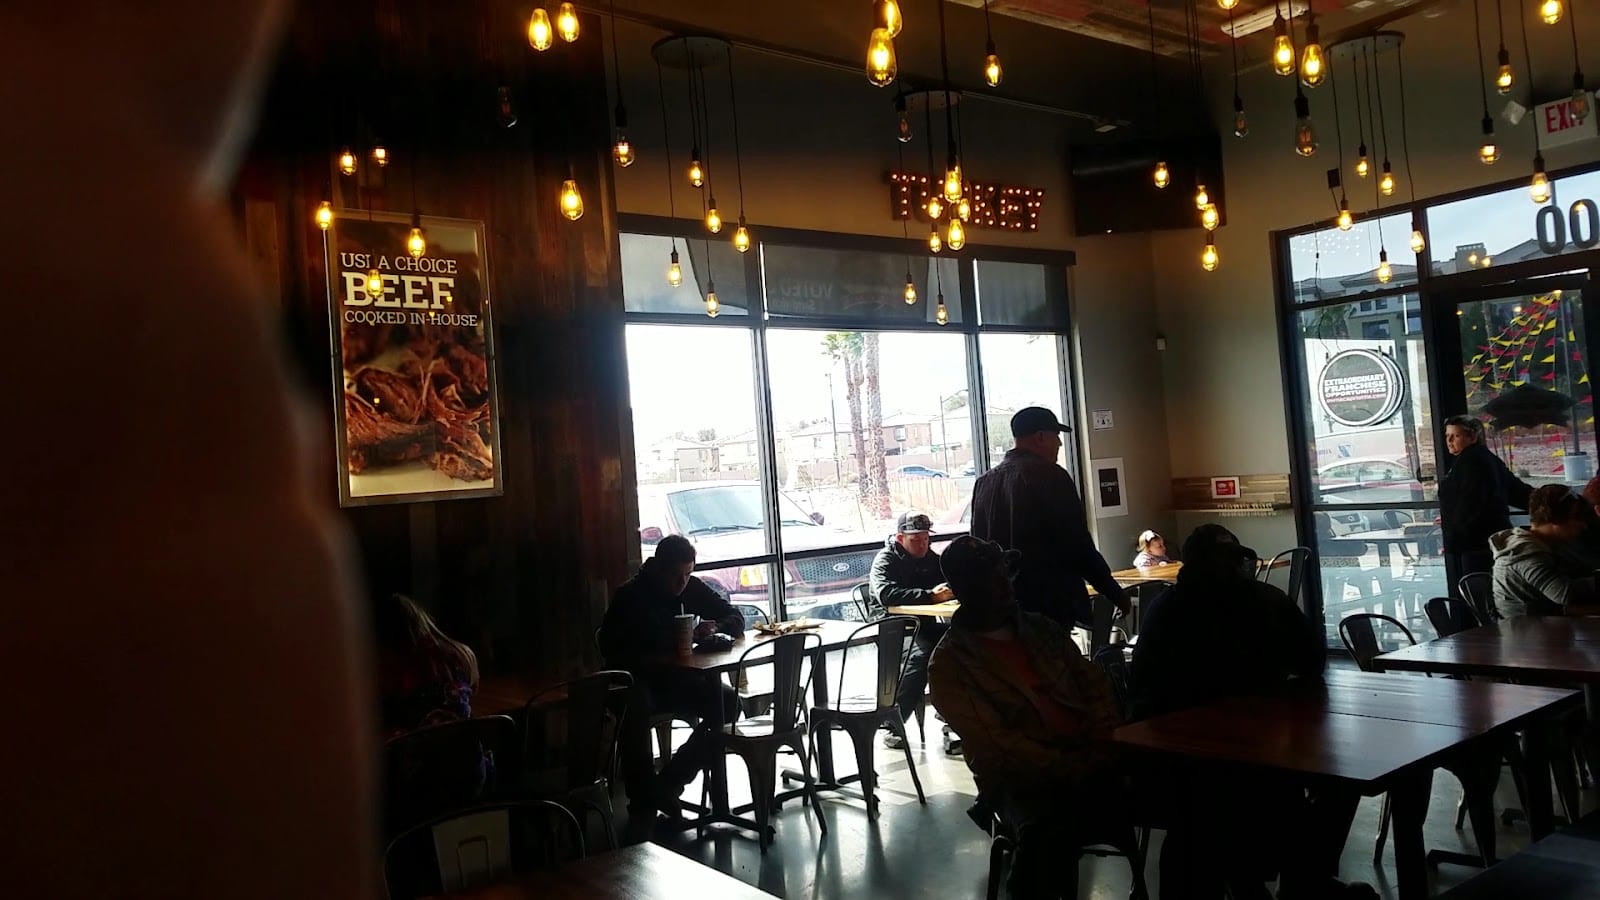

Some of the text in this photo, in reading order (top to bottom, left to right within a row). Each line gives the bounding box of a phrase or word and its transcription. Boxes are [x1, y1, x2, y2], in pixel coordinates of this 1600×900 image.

[1544, 101, 1585, 134] EXI
[394, 255, 458, 274] CHOICE
[341, 271, 455, 310] BEEF
[344, 310, 407, 325] COOKED
[410, 313, 478, 327] IN-HOUSE
[1324, 374, 1385, 387] EXTRAORDINARY
[1324, 380, 1387, 394] FRANCHISE
[1325, 387, 1387, 399] OPPORTUNITIES
